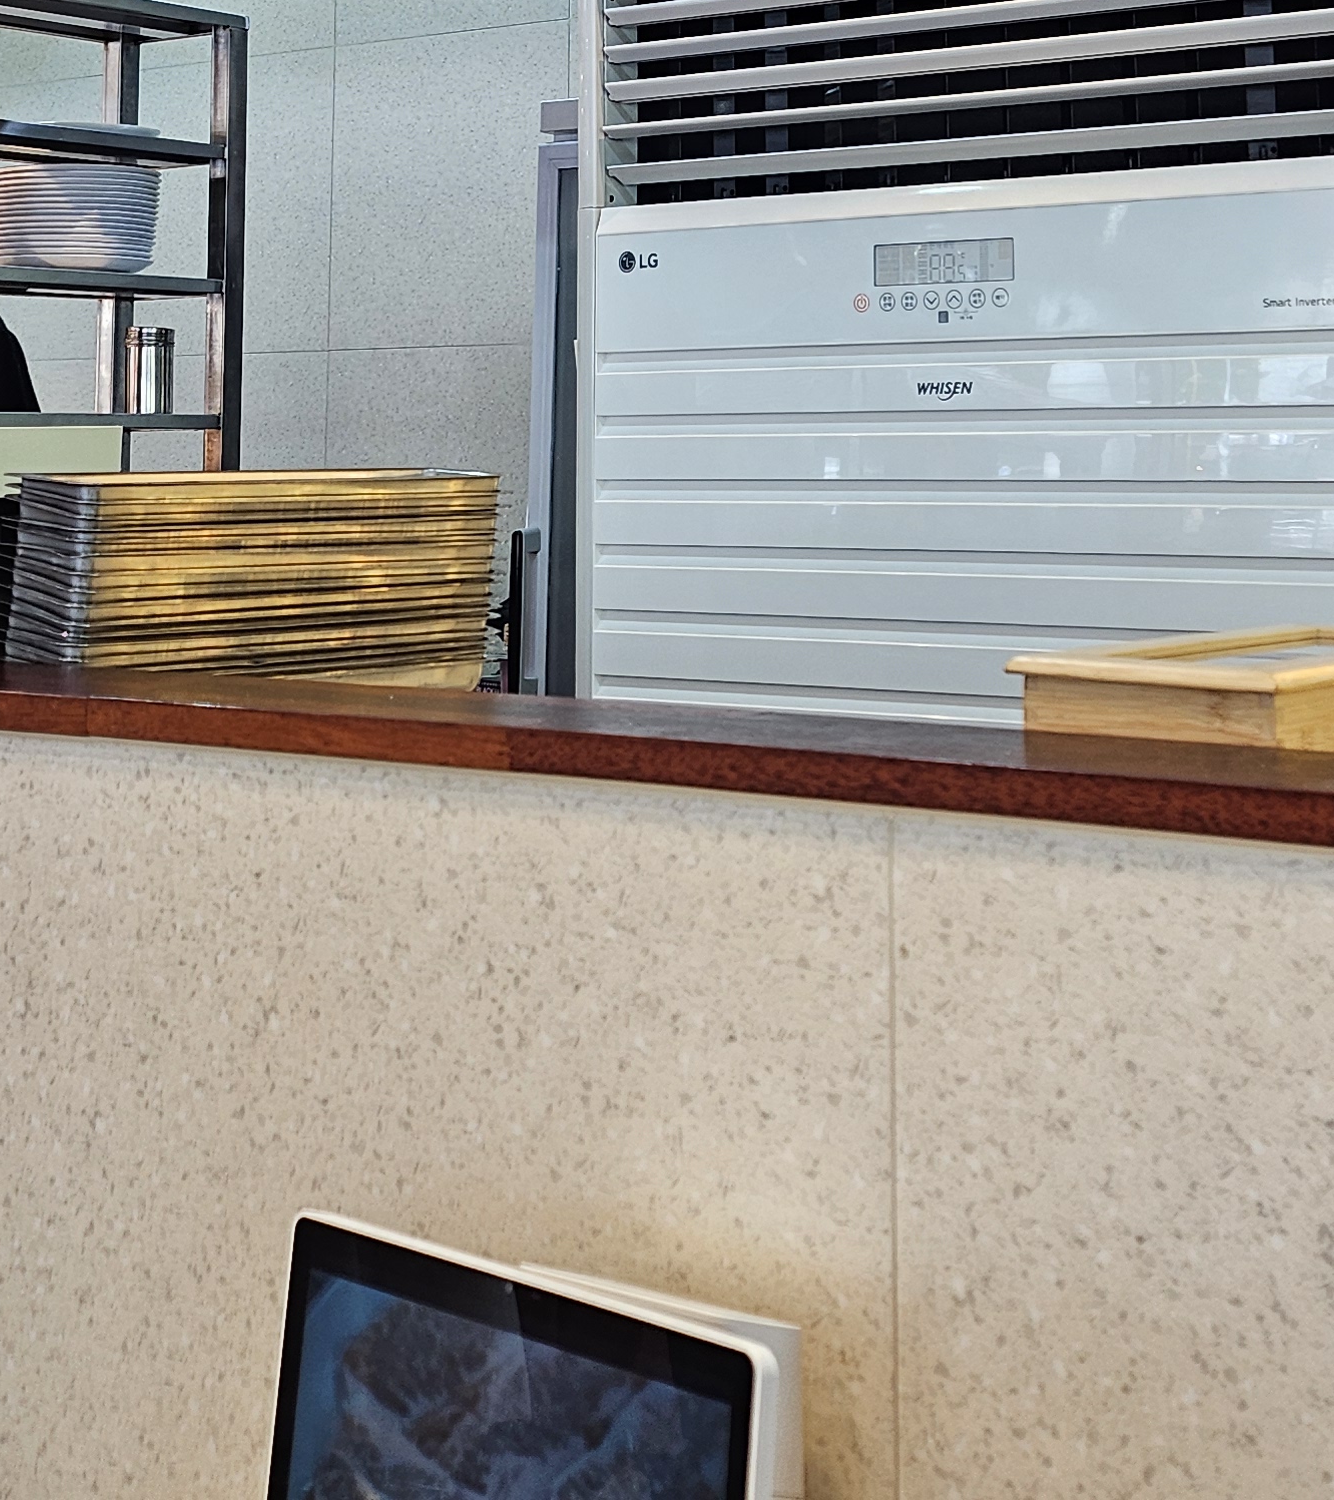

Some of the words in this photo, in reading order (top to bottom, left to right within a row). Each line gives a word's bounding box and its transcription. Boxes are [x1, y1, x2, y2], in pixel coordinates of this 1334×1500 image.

[639, 252, 659, 269] LG
[1262, 297, 1292, 308] Smart
[916, 381, 974, 401] WHISEN
